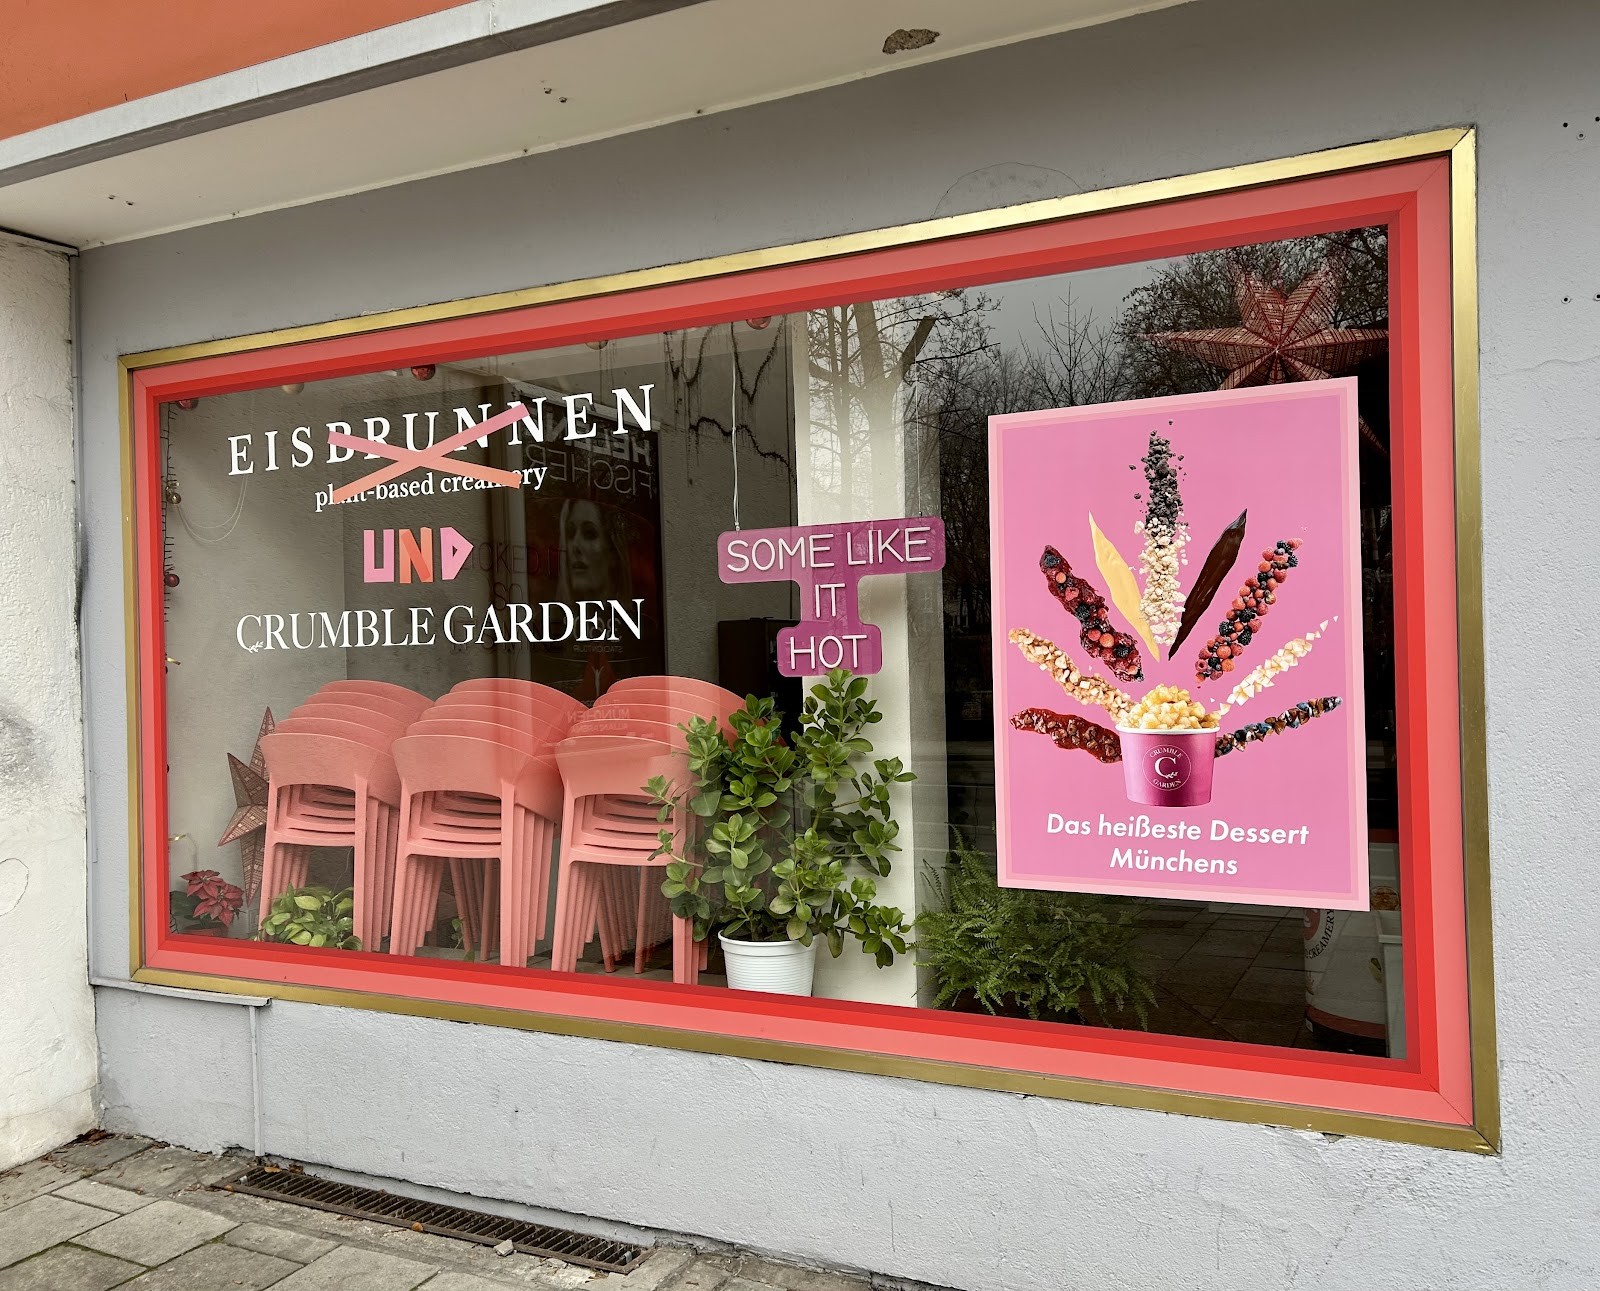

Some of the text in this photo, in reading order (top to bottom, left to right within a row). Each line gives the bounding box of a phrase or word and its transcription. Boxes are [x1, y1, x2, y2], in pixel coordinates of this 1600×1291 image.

[228, 384, 655, 476] EISBRUNNEN
[314, 466, 548, 513] plt-based creary
[363, 527, 474, 584] UND
[727, 526, 932, 573] SOME LIKE
[815, 583, 846, 618] IT
[236, 607, 435, 652] CRUMBLE
[443, 599, 645, 645] GARDEN
[790, 635, 868, 670] HOT
[1150, 747, 1183, 759] CRUMBLE
[1047, 813, 1310, 845] Das heißeste Dessert
[1109, 847, 1238, 875] Münchens
